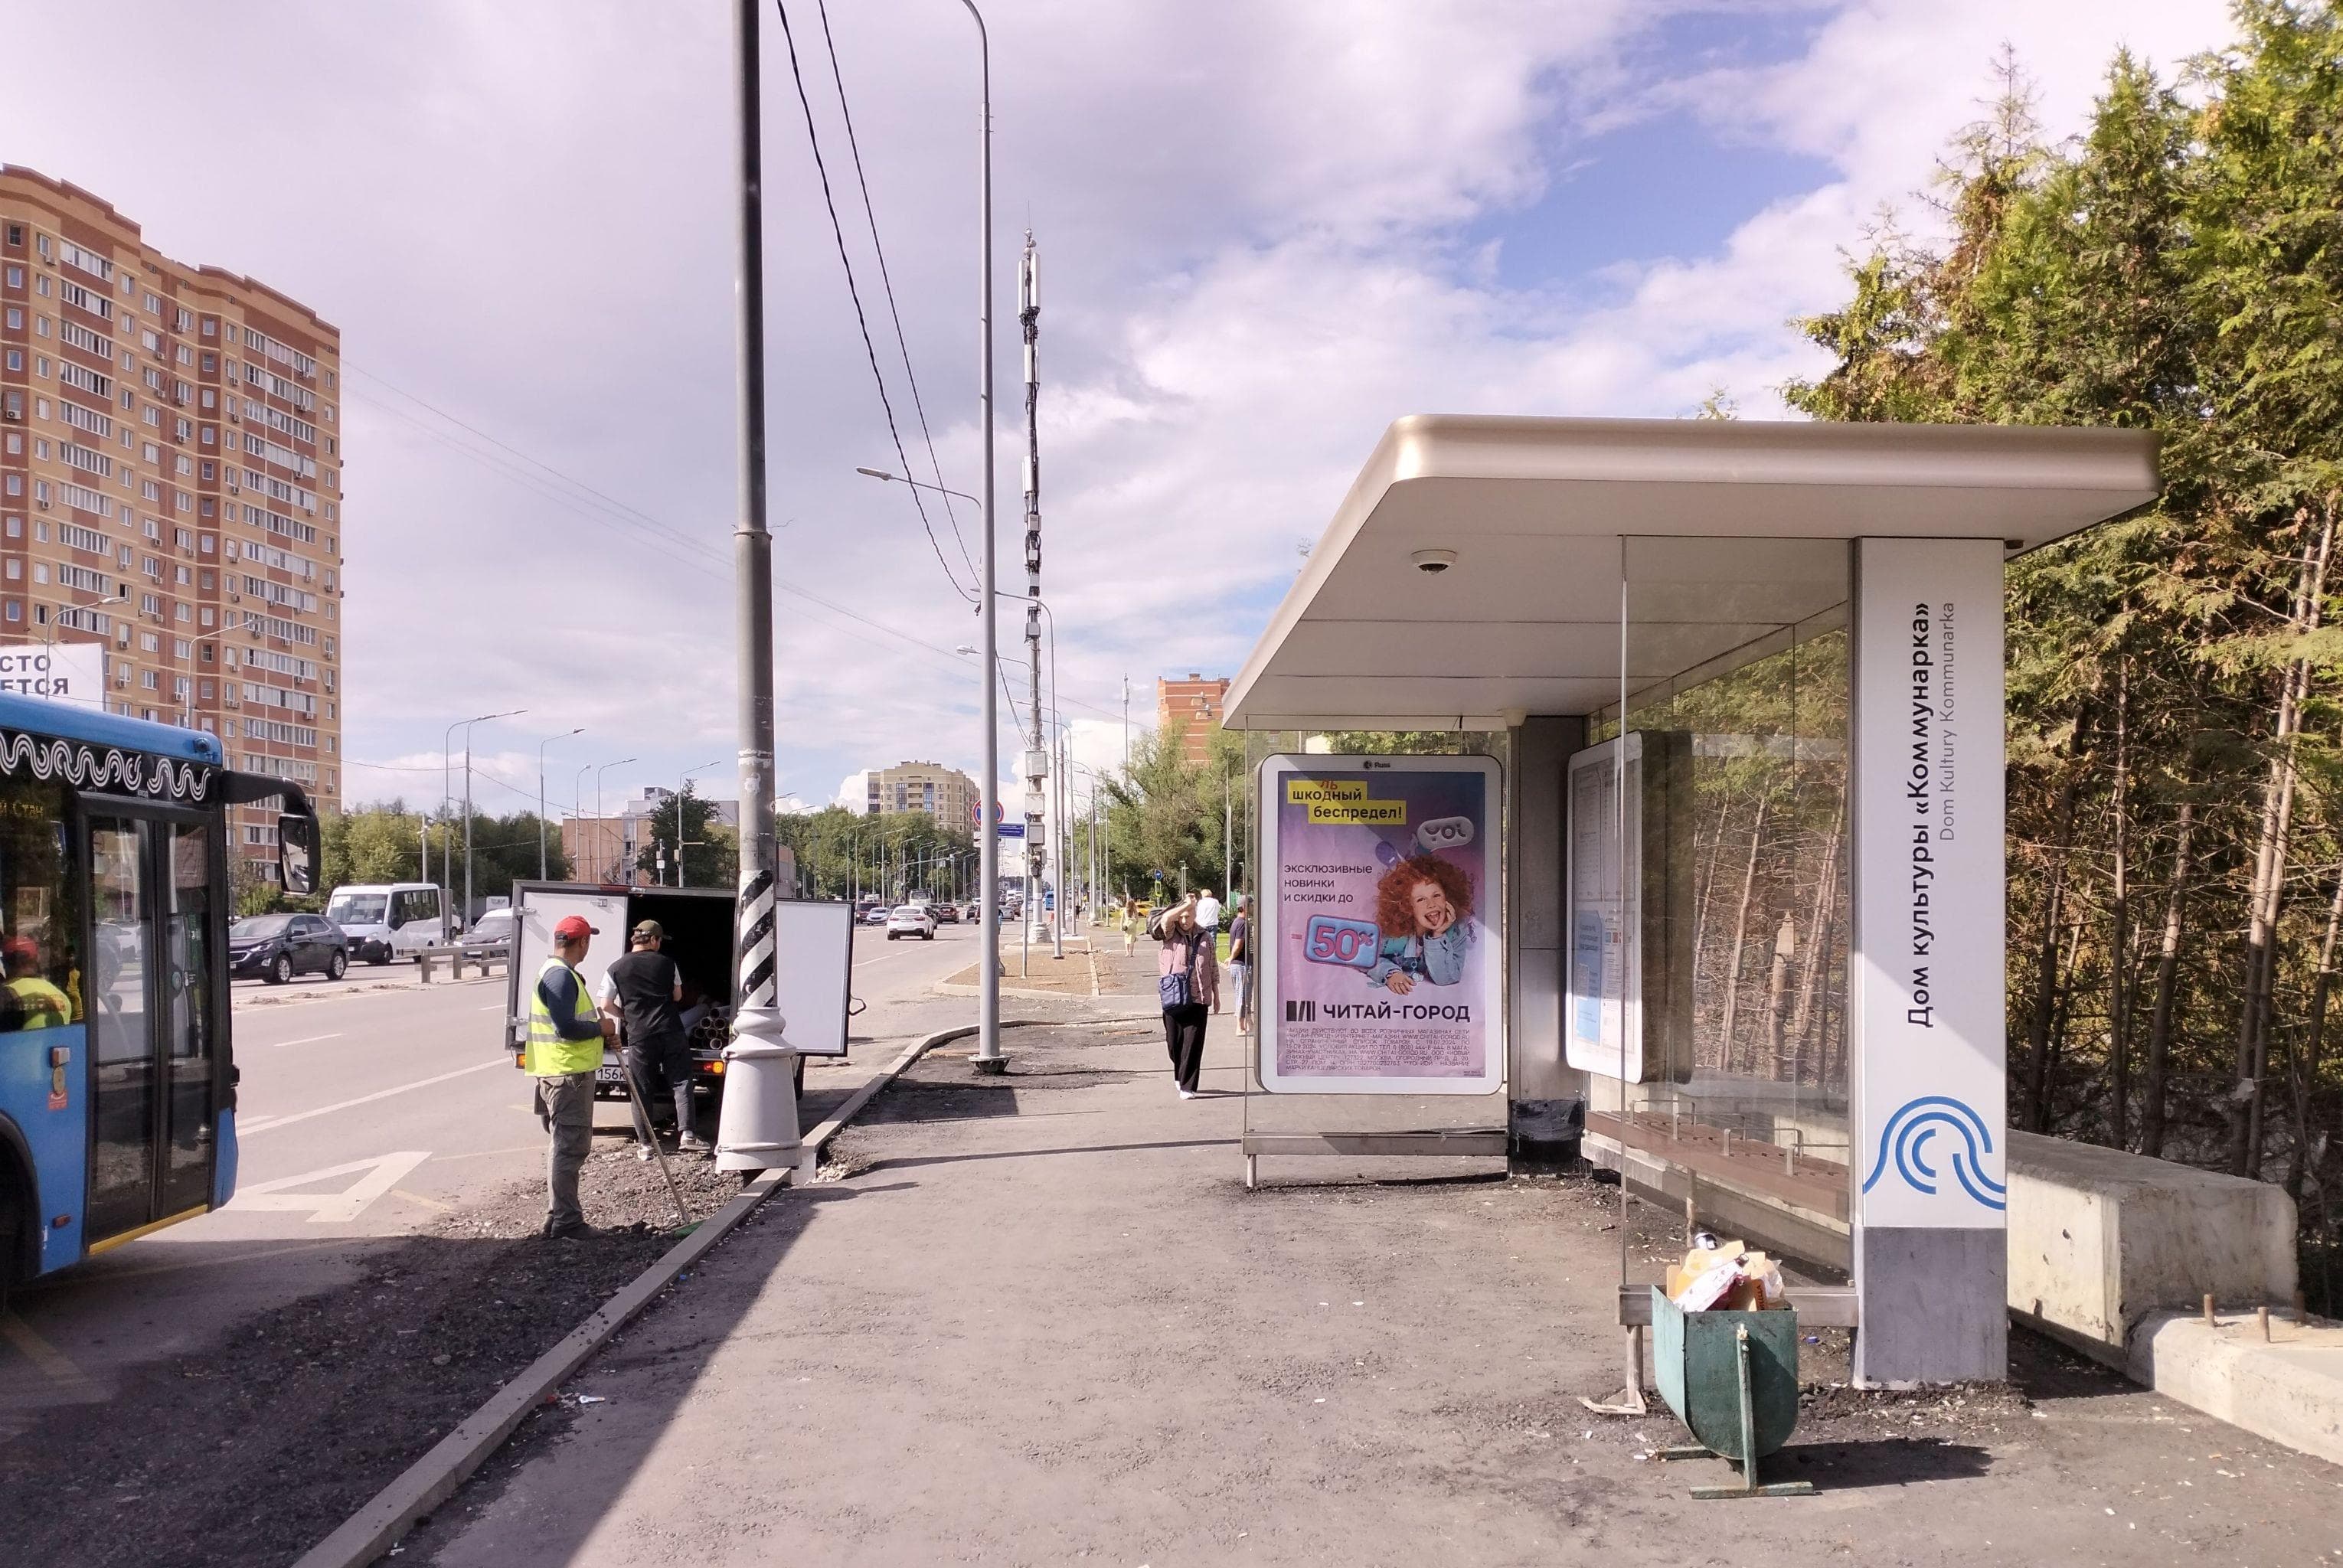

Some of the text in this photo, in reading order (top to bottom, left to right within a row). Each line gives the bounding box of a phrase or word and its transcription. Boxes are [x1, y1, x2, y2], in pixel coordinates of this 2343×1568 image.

[1939, 603, 1957, 841] Dom Kultury Kommunarka
[1313, 805, 1402, 822] беспредел!
[1907, 603, 1935, 1027] Дом культуры «Коммунарка»
[1284, 864, 1373, 874] эксклюзивные
[1284, 879, 1335, 888] новинки
[1284, 893, 1354, 904] и скидки до
[1323, 1001, 1471, 1023] ЧИТАЙ-ГОРОД
